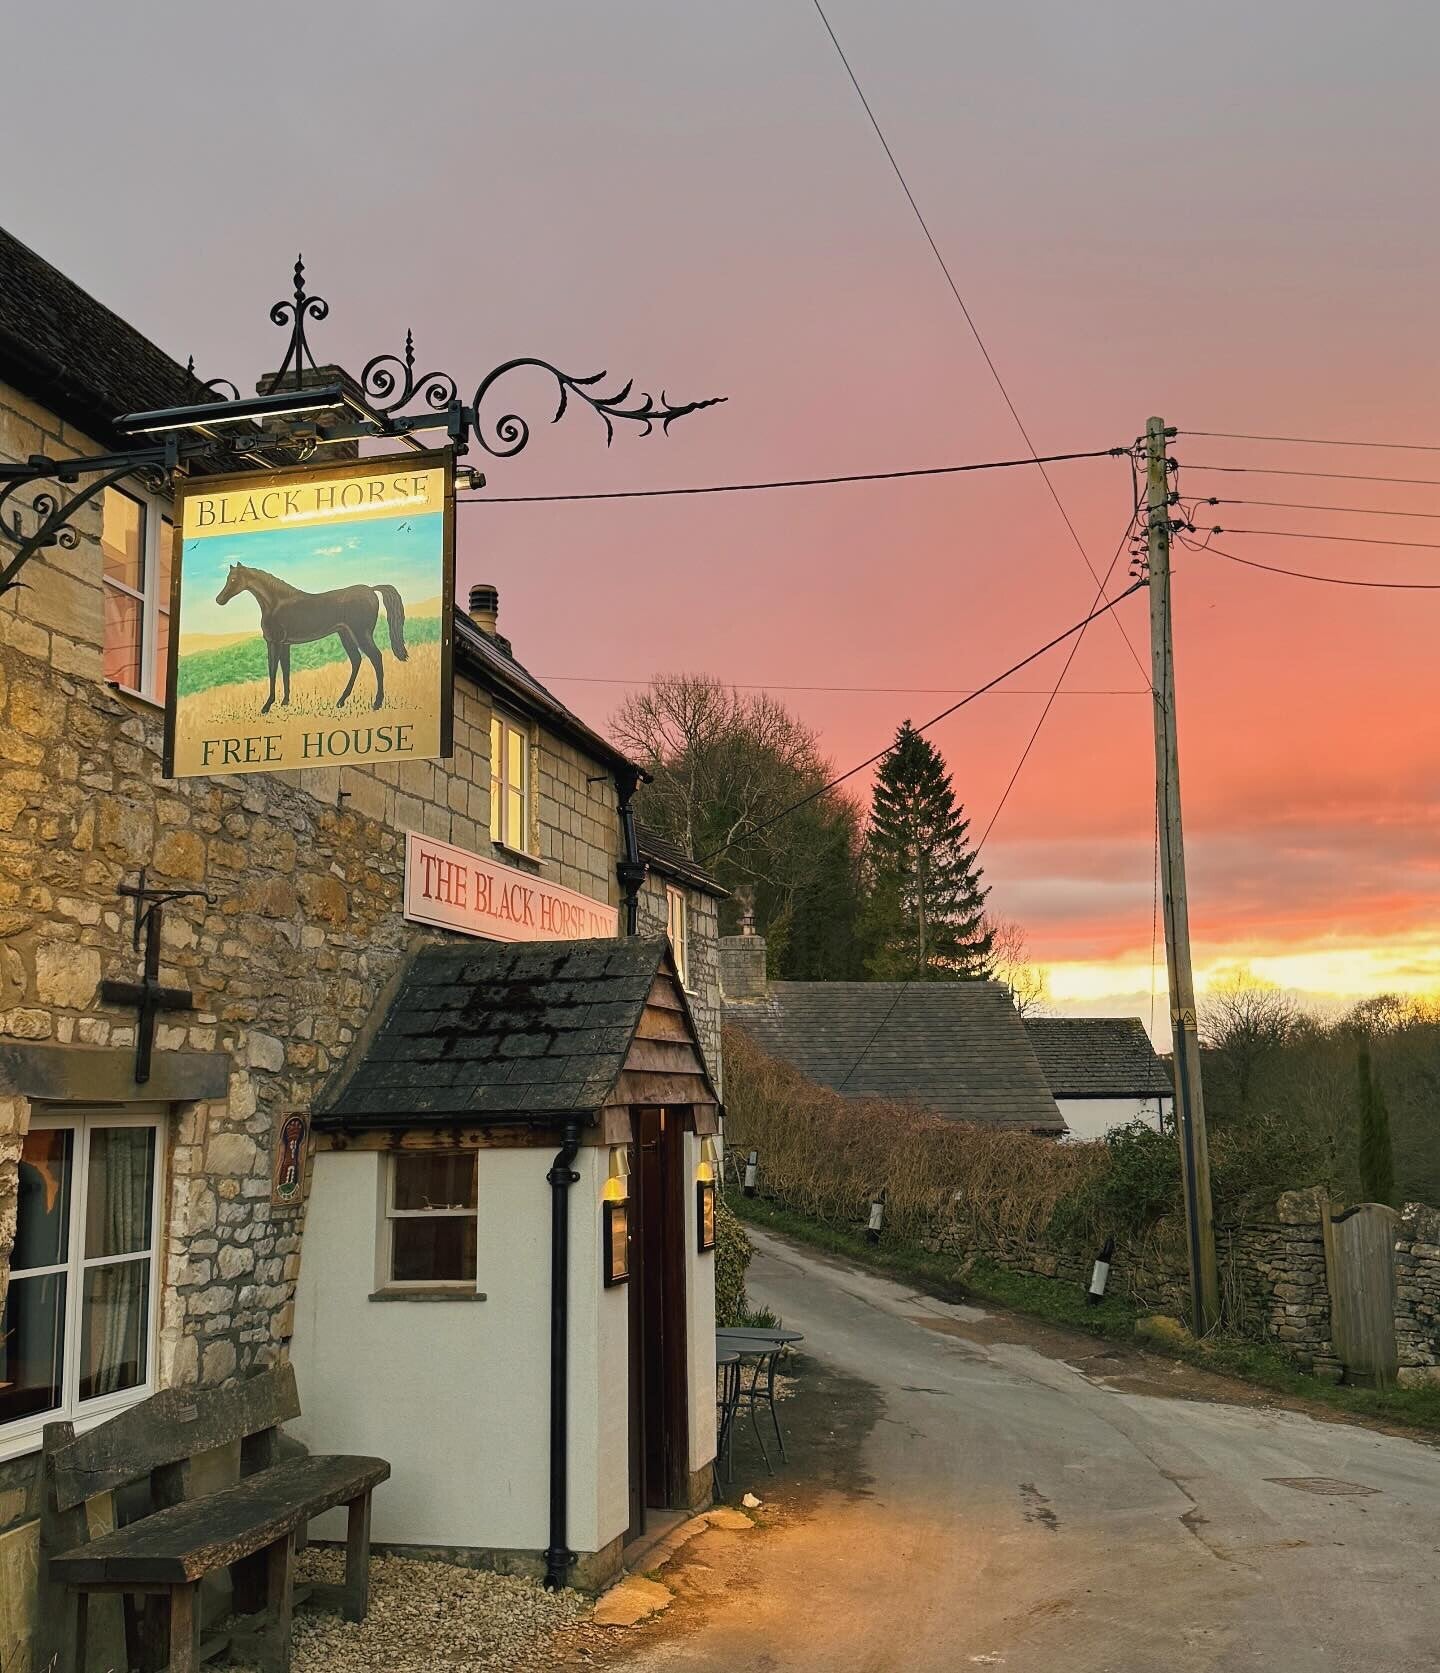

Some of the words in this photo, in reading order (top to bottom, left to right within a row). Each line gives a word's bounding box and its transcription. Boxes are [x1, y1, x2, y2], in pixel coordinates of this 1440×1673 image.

[196, 489, 303, 527] BLACK
[314, 475, 431, 514] HORSE
[201, 735, 283, 766] FREE
[301, 724, 415, 759] HOUSE
[420, 849, 468, 909] THE
[474, 871, 535, 926] BLACK
[540, 893, 585, 938] HORSE
[589, 911, 613, 938] INN
